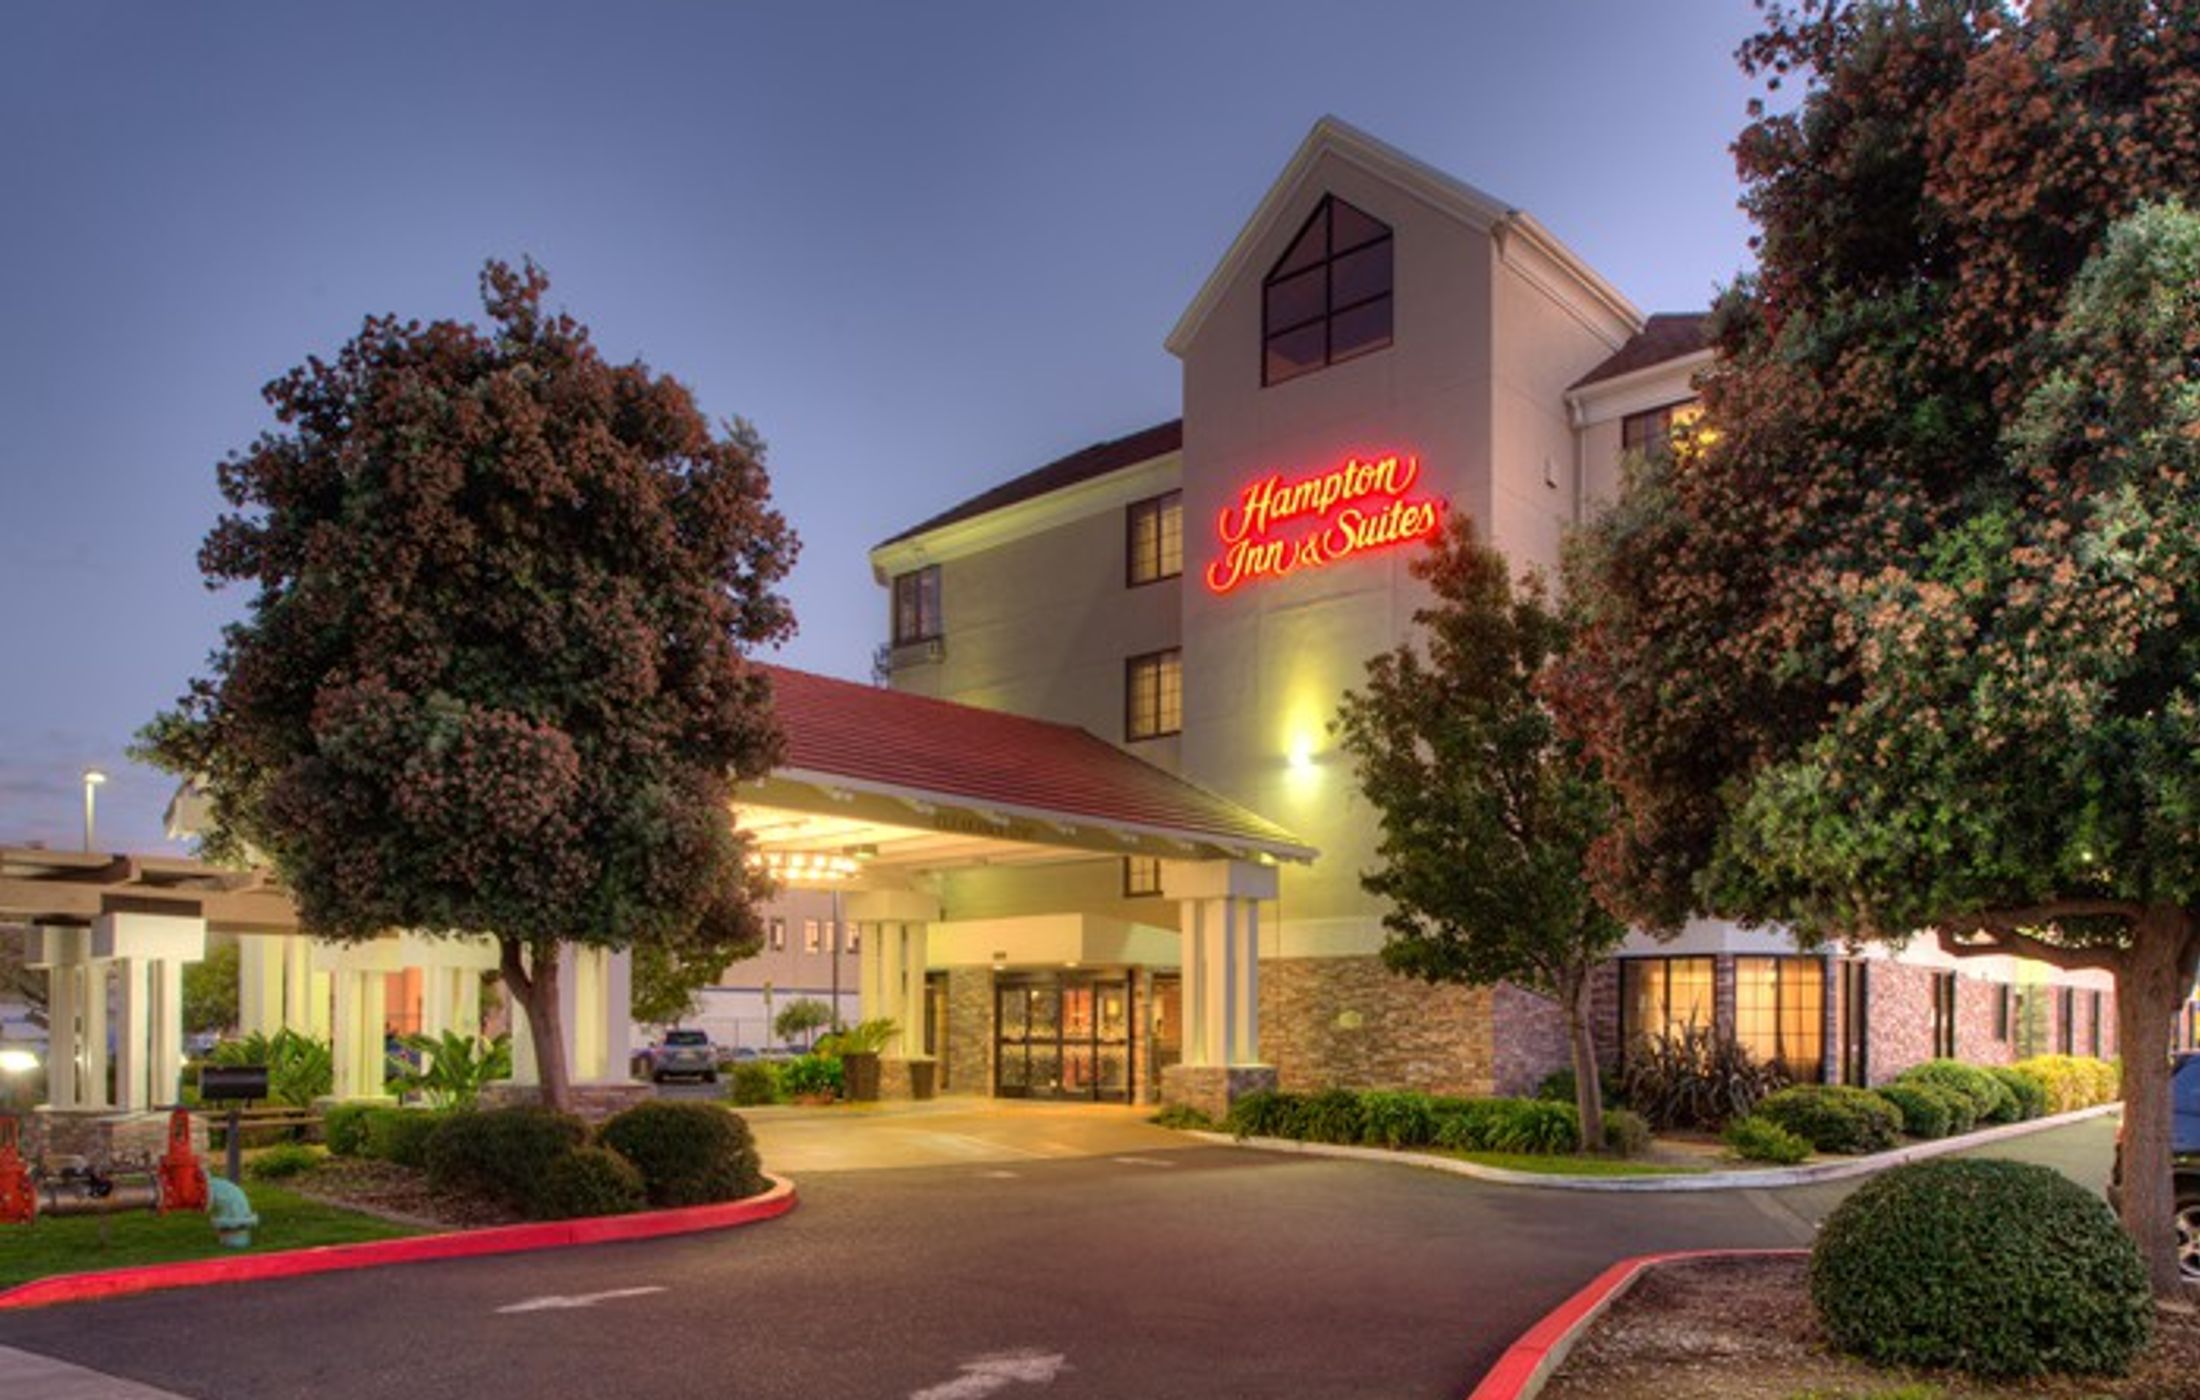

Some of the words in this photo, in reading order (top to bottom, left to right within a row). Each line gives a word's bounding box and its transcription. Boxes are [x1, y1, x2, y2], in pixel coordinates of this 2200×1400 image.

[1218, 455, 1419, 542] Hampton
[1207, 537, 1300, 591] Inn
[1301, 533, 1323, 566] &
[1323, 499, 1435, 558] Suites
